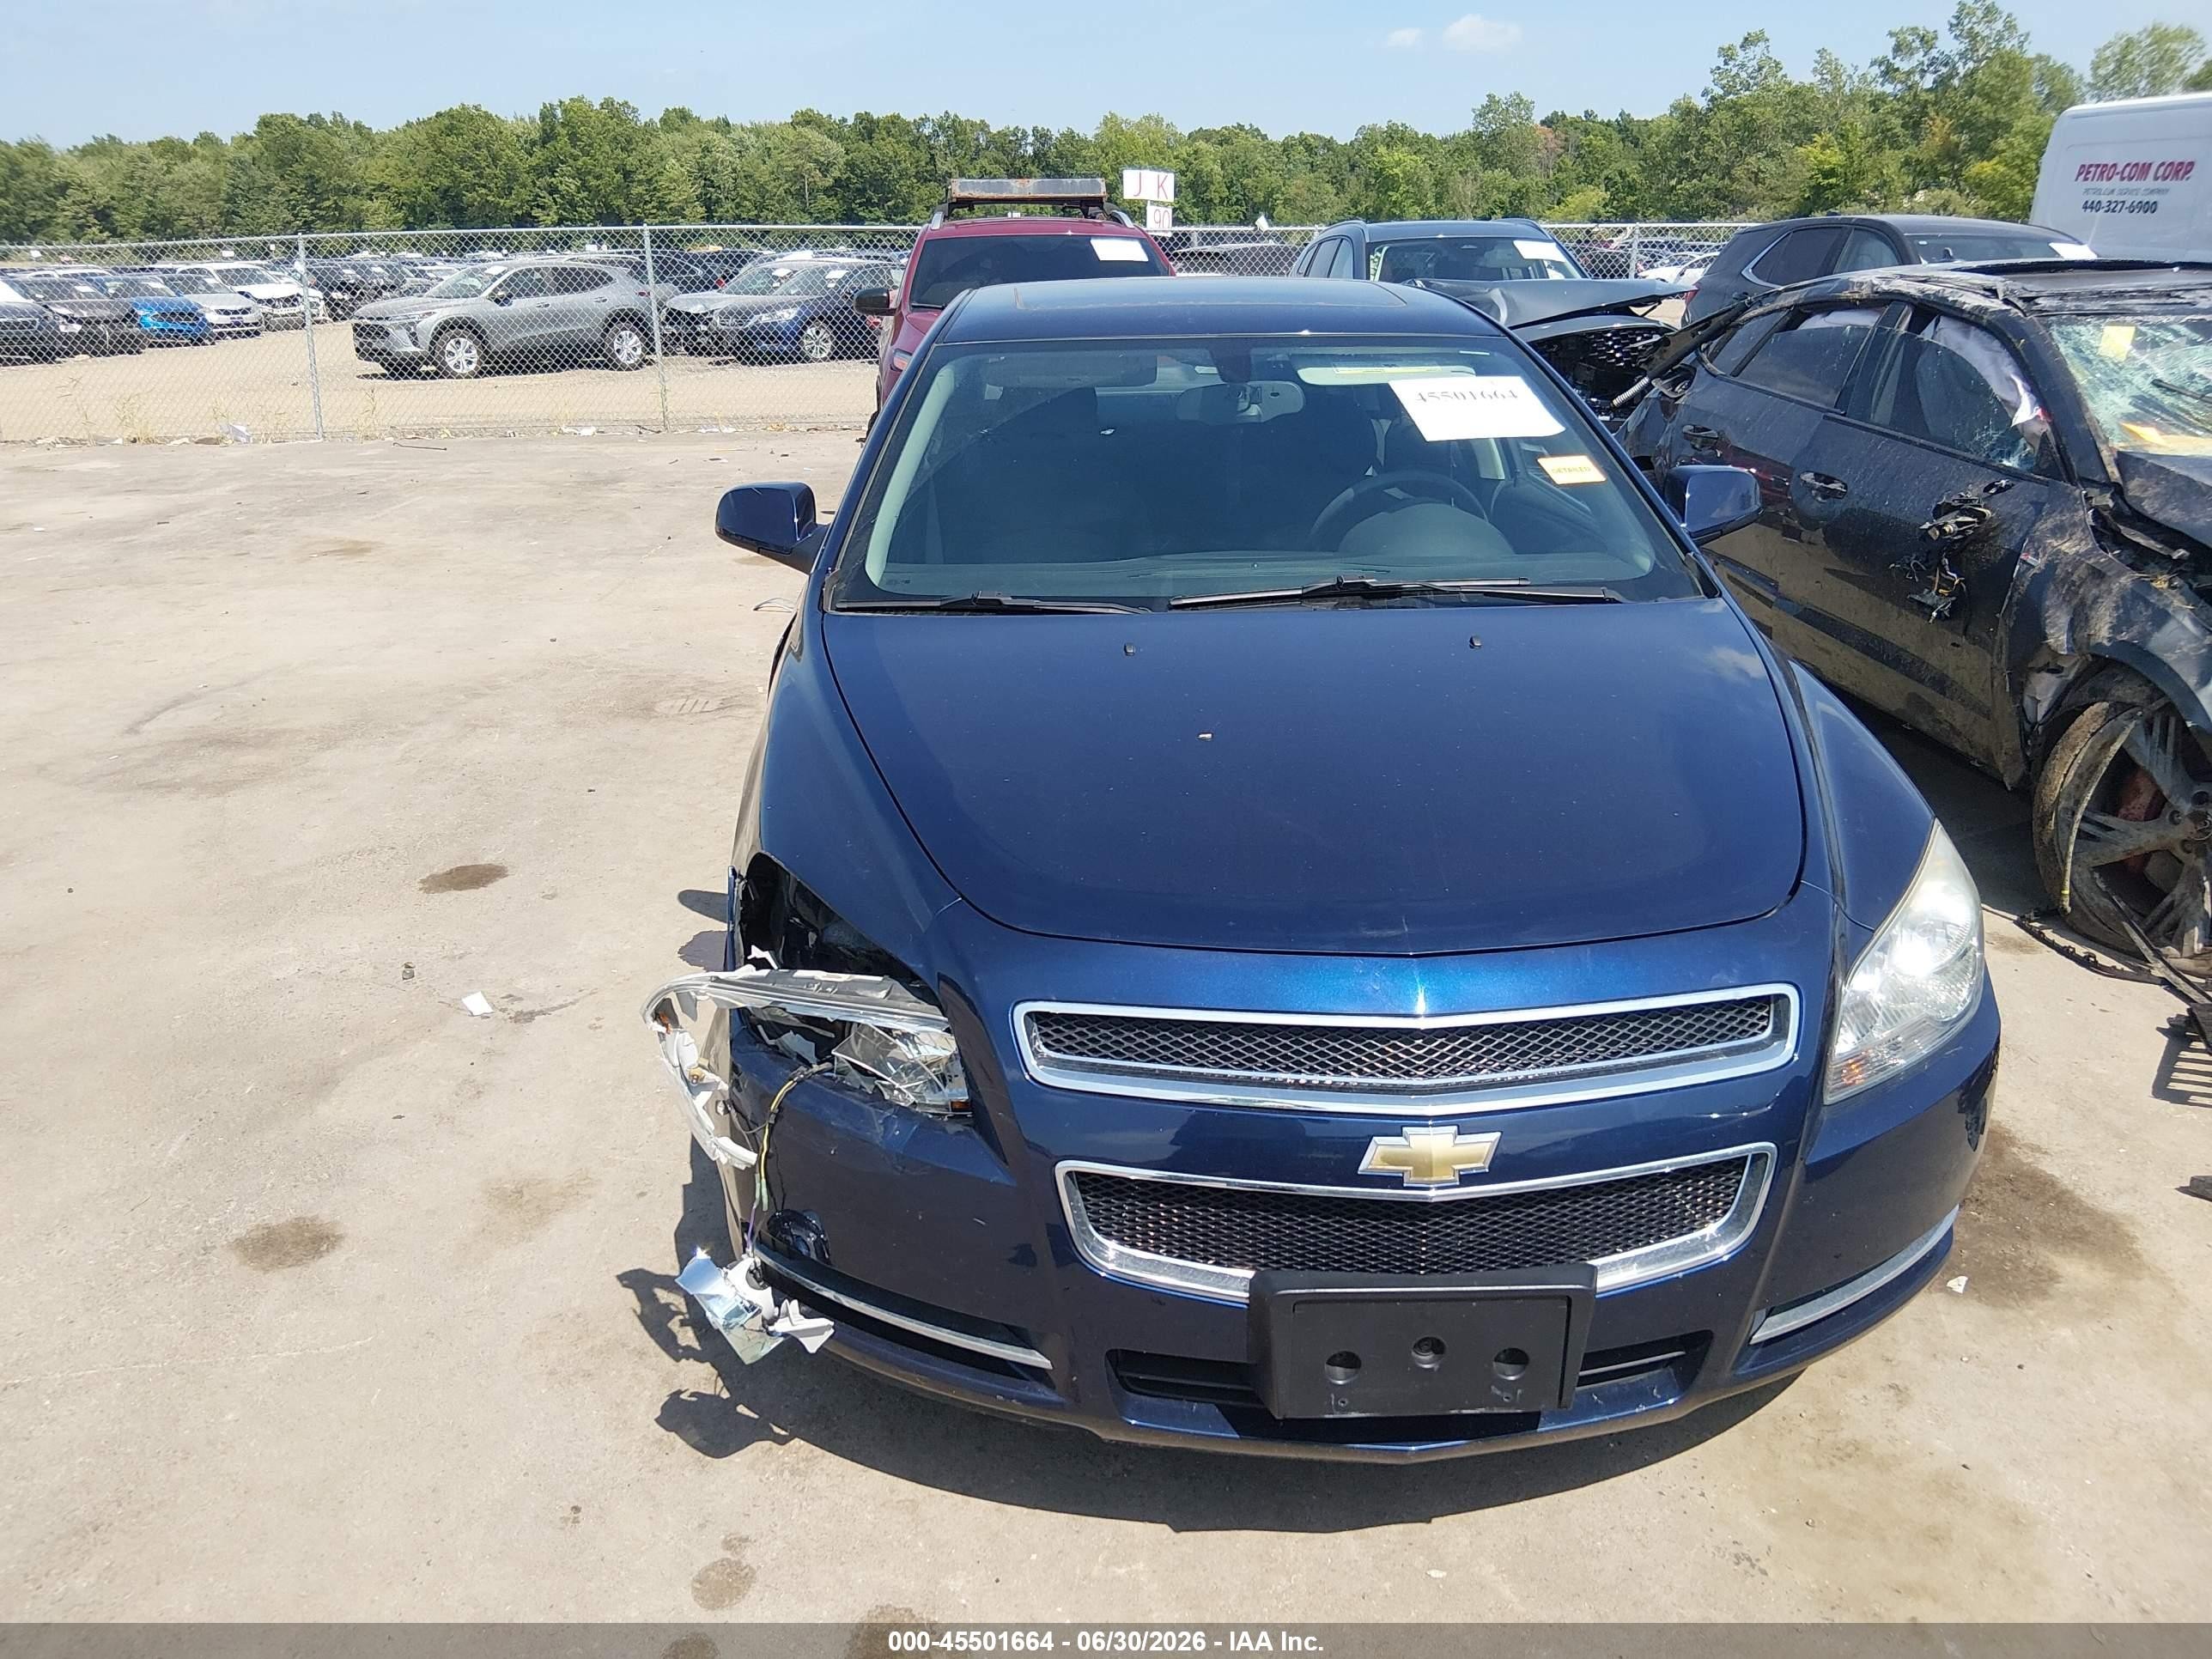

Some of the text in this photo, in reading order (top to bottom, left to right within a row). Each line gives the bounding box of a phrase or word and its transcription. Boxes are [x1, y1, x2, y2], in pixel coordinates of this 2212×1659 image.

[2075, 161, 2195, 182] PETRO-COM CORP.
[1133, 172, 1168, 200] J K
[2081, 199, 2158, 214] 440-327-6900
